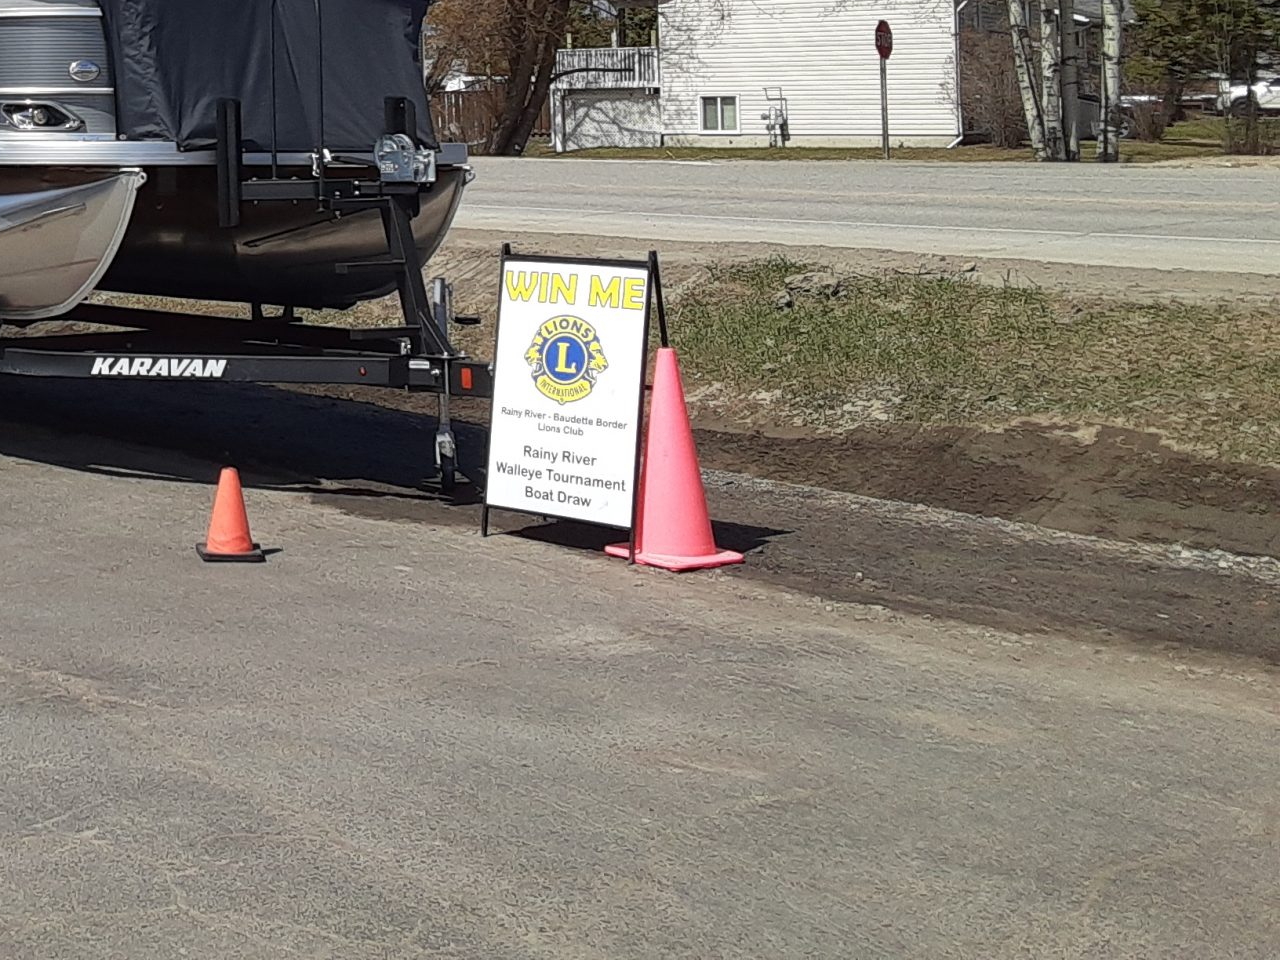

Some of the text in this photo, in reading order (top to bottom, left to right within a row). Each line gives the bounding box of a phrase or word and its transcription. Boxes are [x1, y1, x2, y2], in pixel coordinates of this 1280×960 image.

[504, 269, 646, 311] WIN ME
[544, 318, 592, 339] LIONS
[91, 357, 227, 378] KARAVAN
[554, 342, 578, 374] L
[539, 378, 589, 398] INTERNATIONAL
[501, 406, 522, 418] Rainy
[524, 409, 547, 420] River
[553, 413, 594, 426] Baudette
[596, 418, 628, 430] Border
[537, 423, 584, 436] Lions Club
[523, 445, 598, 467] Rainy River
[496, 461, 627, 492] Walleye Tournament
[524, 486, 592, 507] Boat Draw
